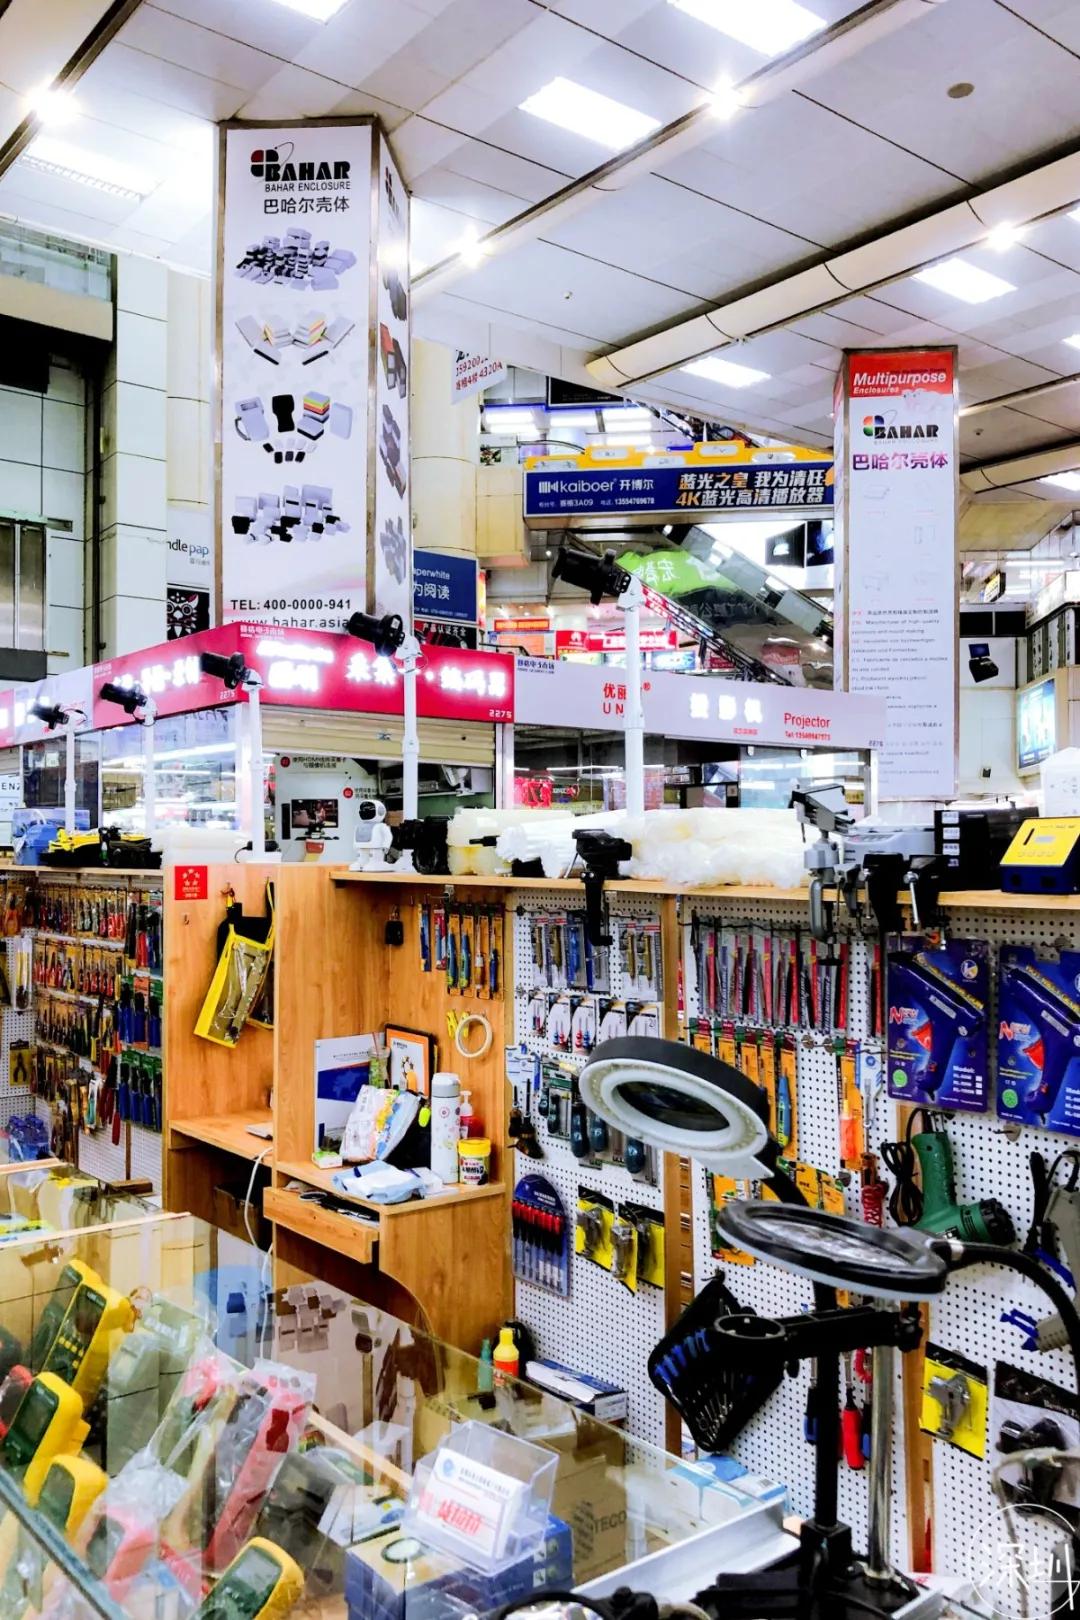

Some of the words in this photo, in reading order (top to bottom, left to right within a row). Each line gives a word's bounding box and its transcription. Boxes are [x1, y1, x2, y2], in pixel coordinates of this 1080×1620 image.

[264, 161, 350, 182] BAHAR
[264, 183, 295, 193] BAHAR
[298, 181, 351, 191] ENCLOSURE
[263, 196, 350, 215] 巴哈尔壳体
[853, 371, 947, 387] Multipurpose
[853, 386, 900, 395] Enclosures
[874, 424, 939, 440] BAHAR
[852, 452, 949, 471] 巴哈尔壳体
[560, 480, 614, 493] kaiboer
[620, 479, 655, 491] 开博尔
[678, 472, 749, 491] 蓝光之皇
[231, 599, 261, 611] TEL:
[263, 599, 351, 611] 400-0000-941
[784, 712, 831, 729] Projector
